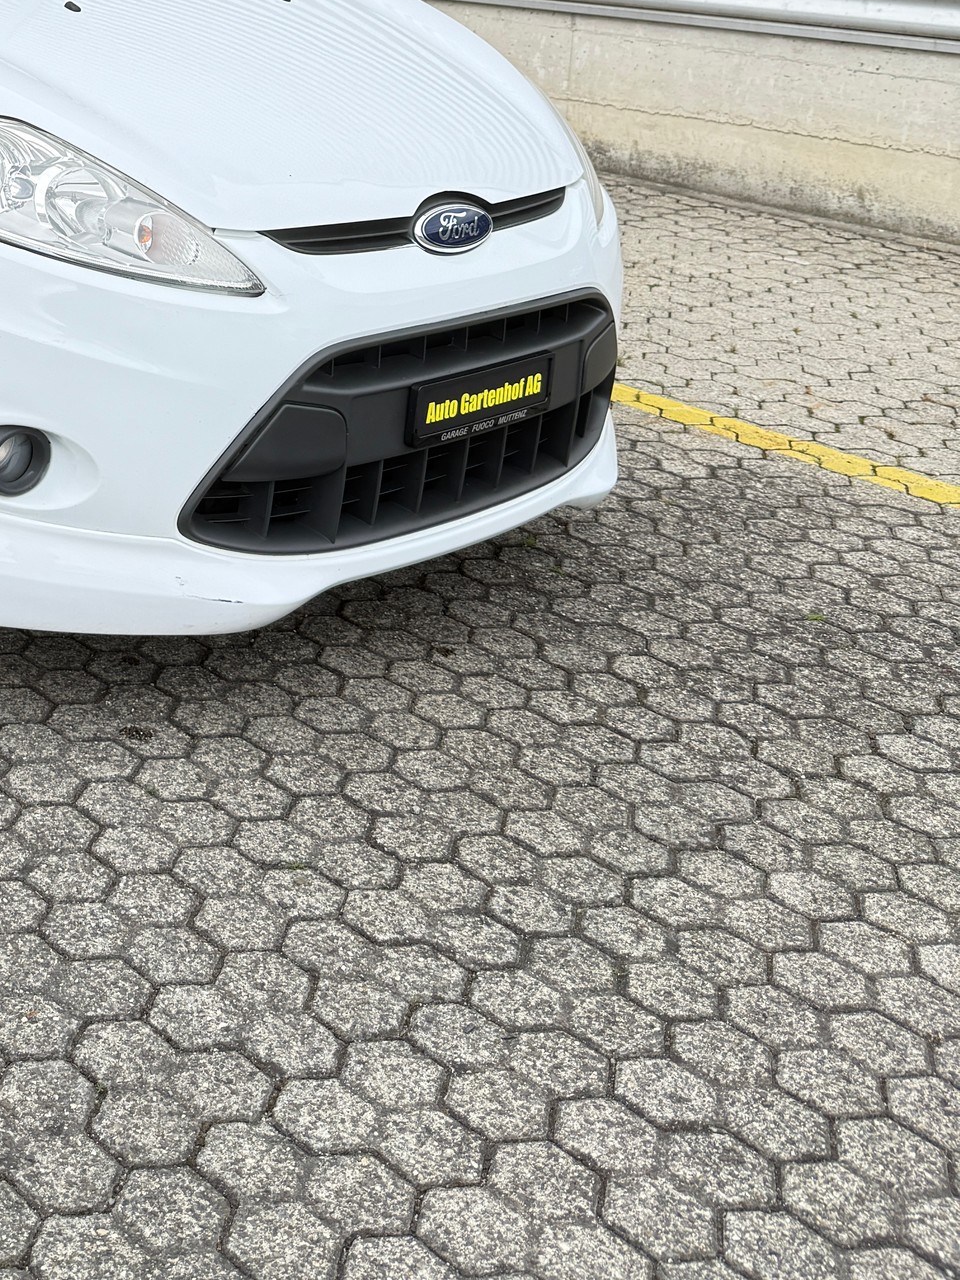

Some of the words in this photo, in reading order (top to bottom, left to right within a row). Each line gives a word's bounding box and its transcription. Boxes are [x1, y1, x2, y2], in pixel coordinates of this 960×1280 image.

[438, 212, 480, 241] Ford
[425, 399, 458, 424] Auto
[460, 377, 525, 415] Gartenhof
[525, 372, 542, 395] AG
[440, 427, 469, 441] GARAGE
[471, 419, 495, 432] FUOCO
[497, 409, 527, 426] MUTTENZ
